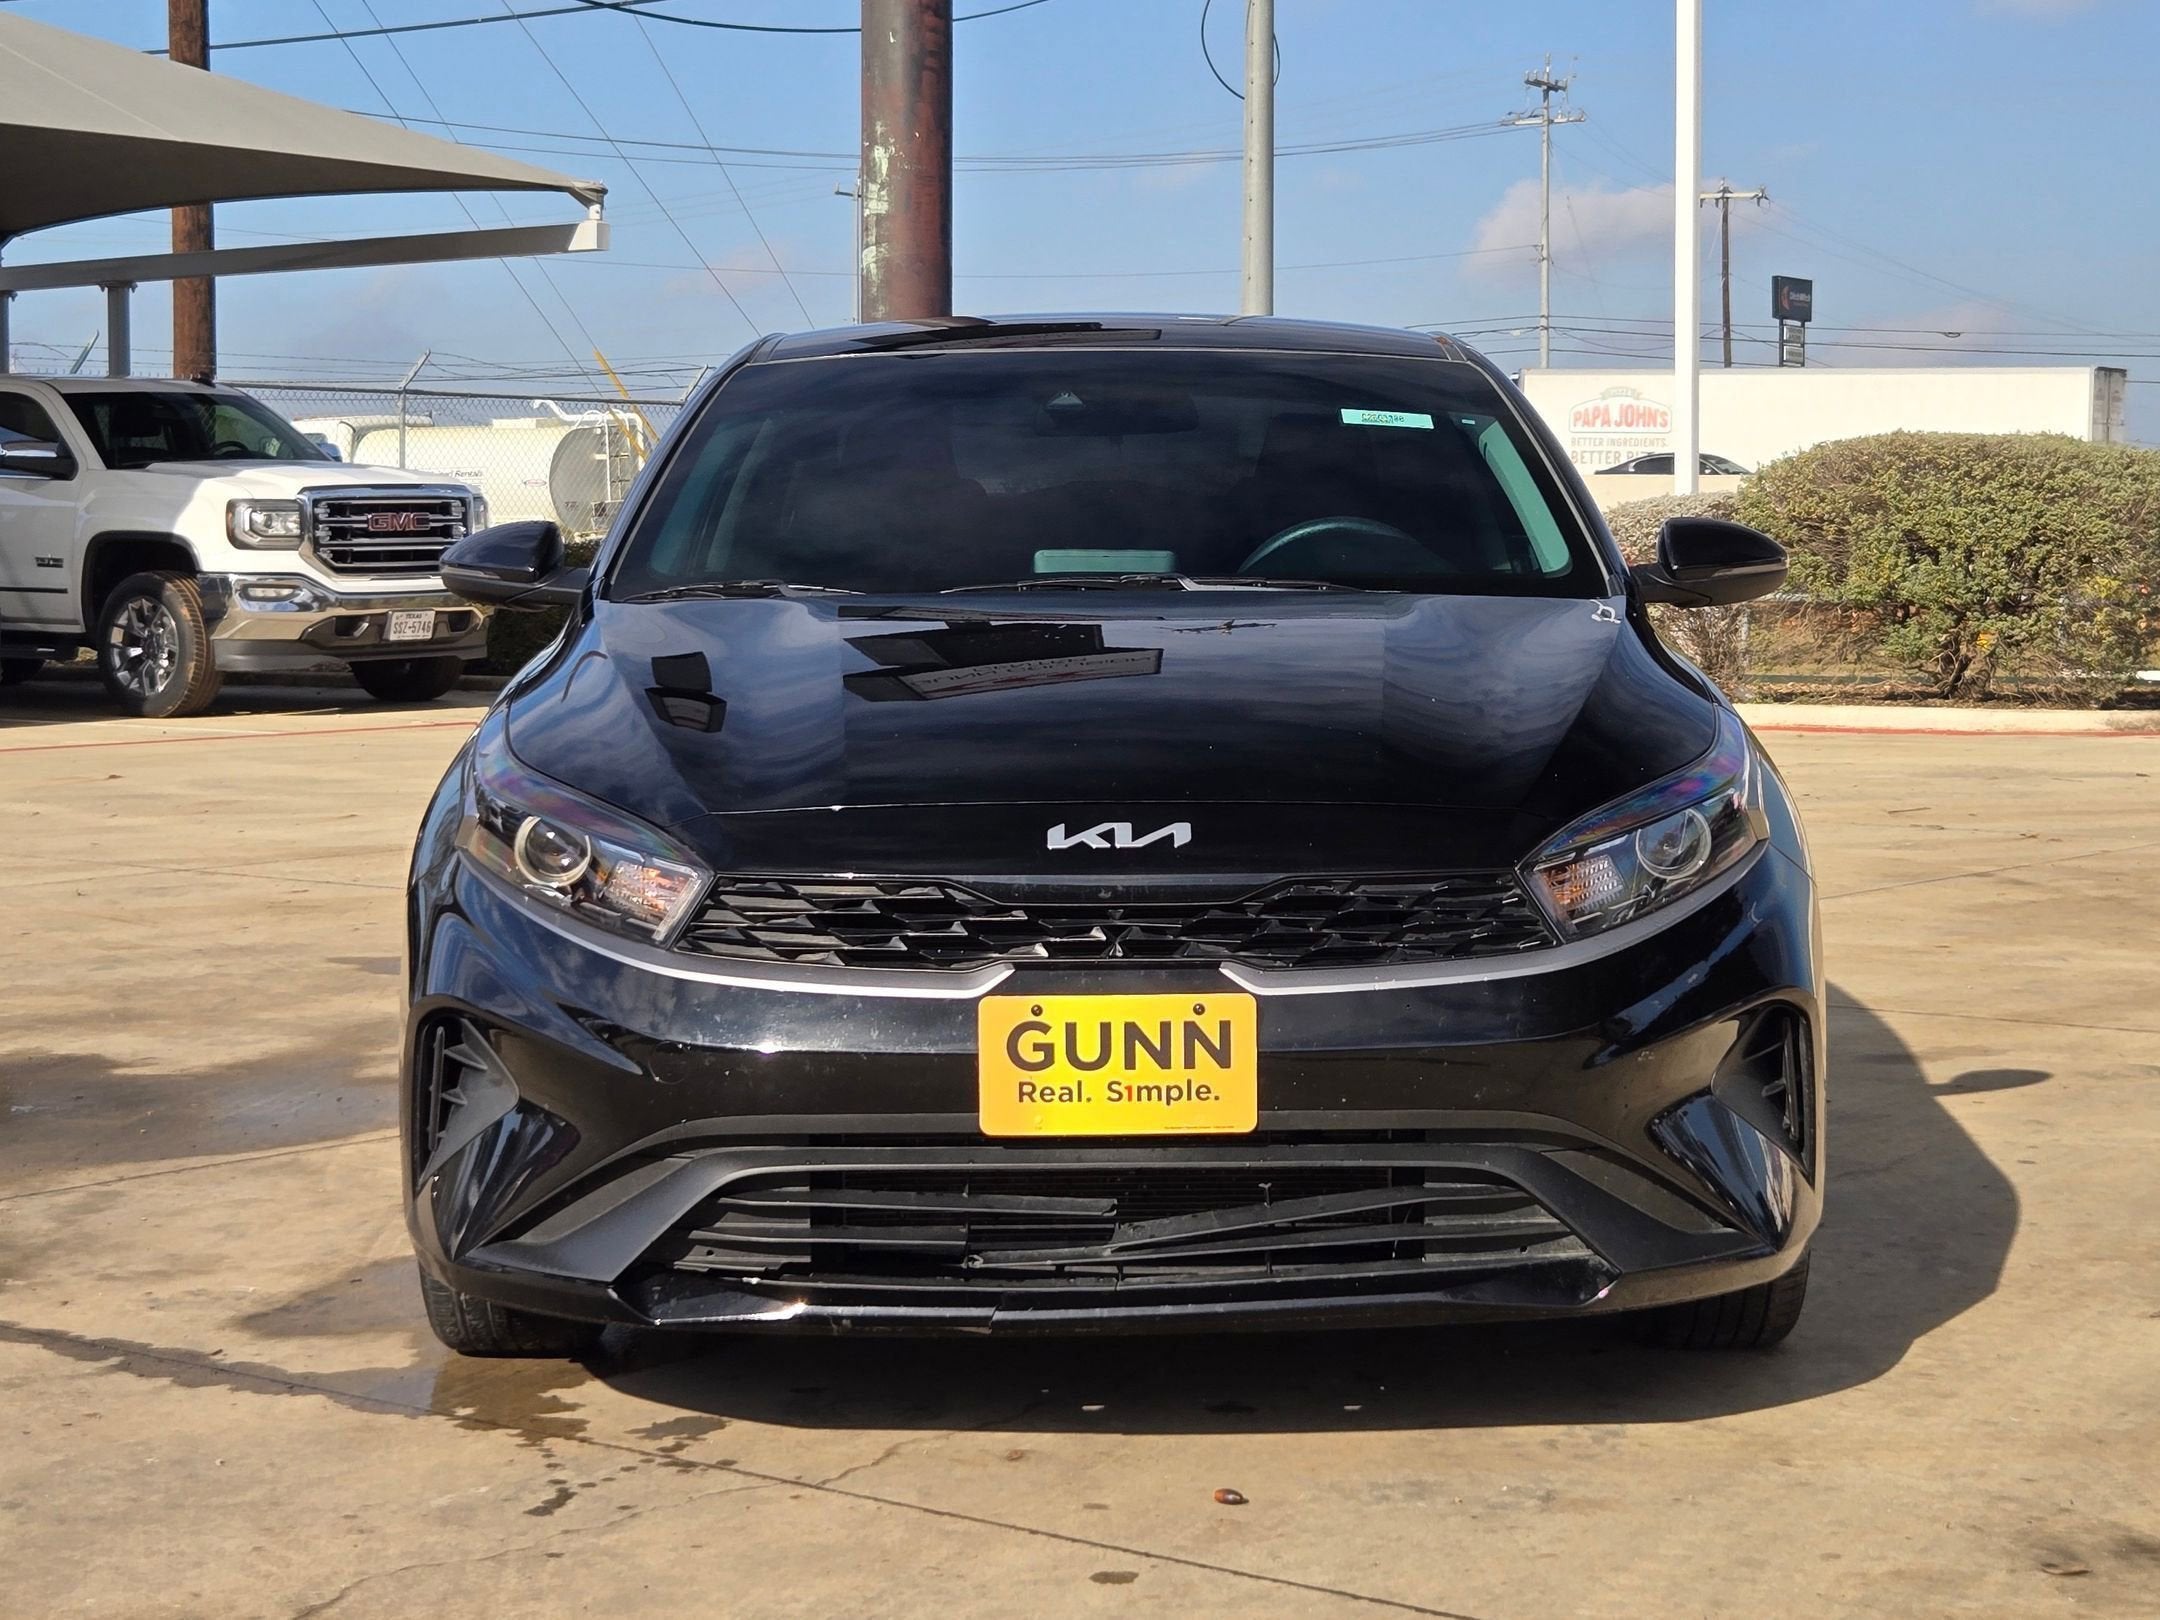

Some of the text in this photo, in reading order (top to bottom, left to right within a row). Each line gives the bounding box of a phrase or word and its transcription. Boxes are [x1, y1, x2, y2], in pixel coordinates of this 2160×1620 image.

[1573, 403, 1669, 428] PAPA JOHN'S
[1571, 437, 1604, 447] BETTER
[1571, 450, 1621, 465] BETTER
[368, 512, 431, 531] GMC
[1047, 822, 1192, 850] KIA
[1006, 1020, 1232, 1072] GUNN
[1018, 1080, 1092, 1103] Real.
